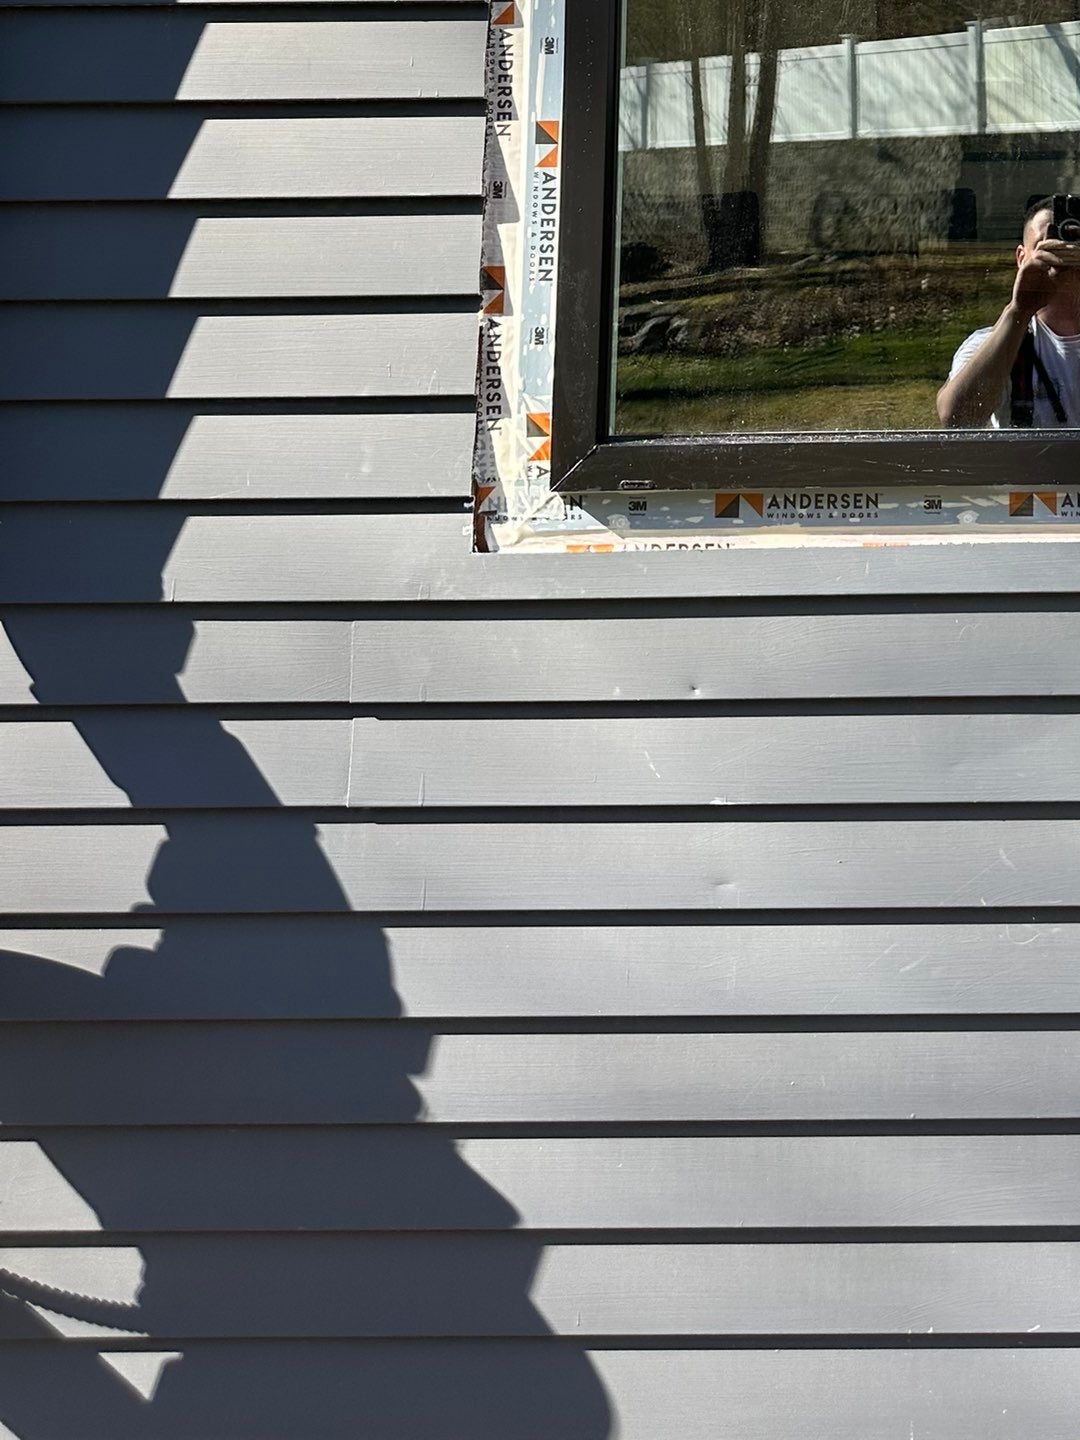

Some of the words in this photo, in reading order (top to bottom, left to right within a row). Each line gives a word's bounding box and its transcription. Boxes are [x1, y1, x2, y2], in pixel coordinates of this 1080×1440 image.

[545, 37, 555, 55] 3M
[496, 29, 514, 137] ANDERSEN
[493, 181, 503, 199] 3M
[538, 172, 557, 282] ANDERSEN
[534, 327, 544, 345] 3M
[486, 318, 502, 432] ANDERSEN
[628, 500, 647, 512] 3M
[767, 493, 879, 510] ANDERSEN
[924, 499, 942, 510] 3M
